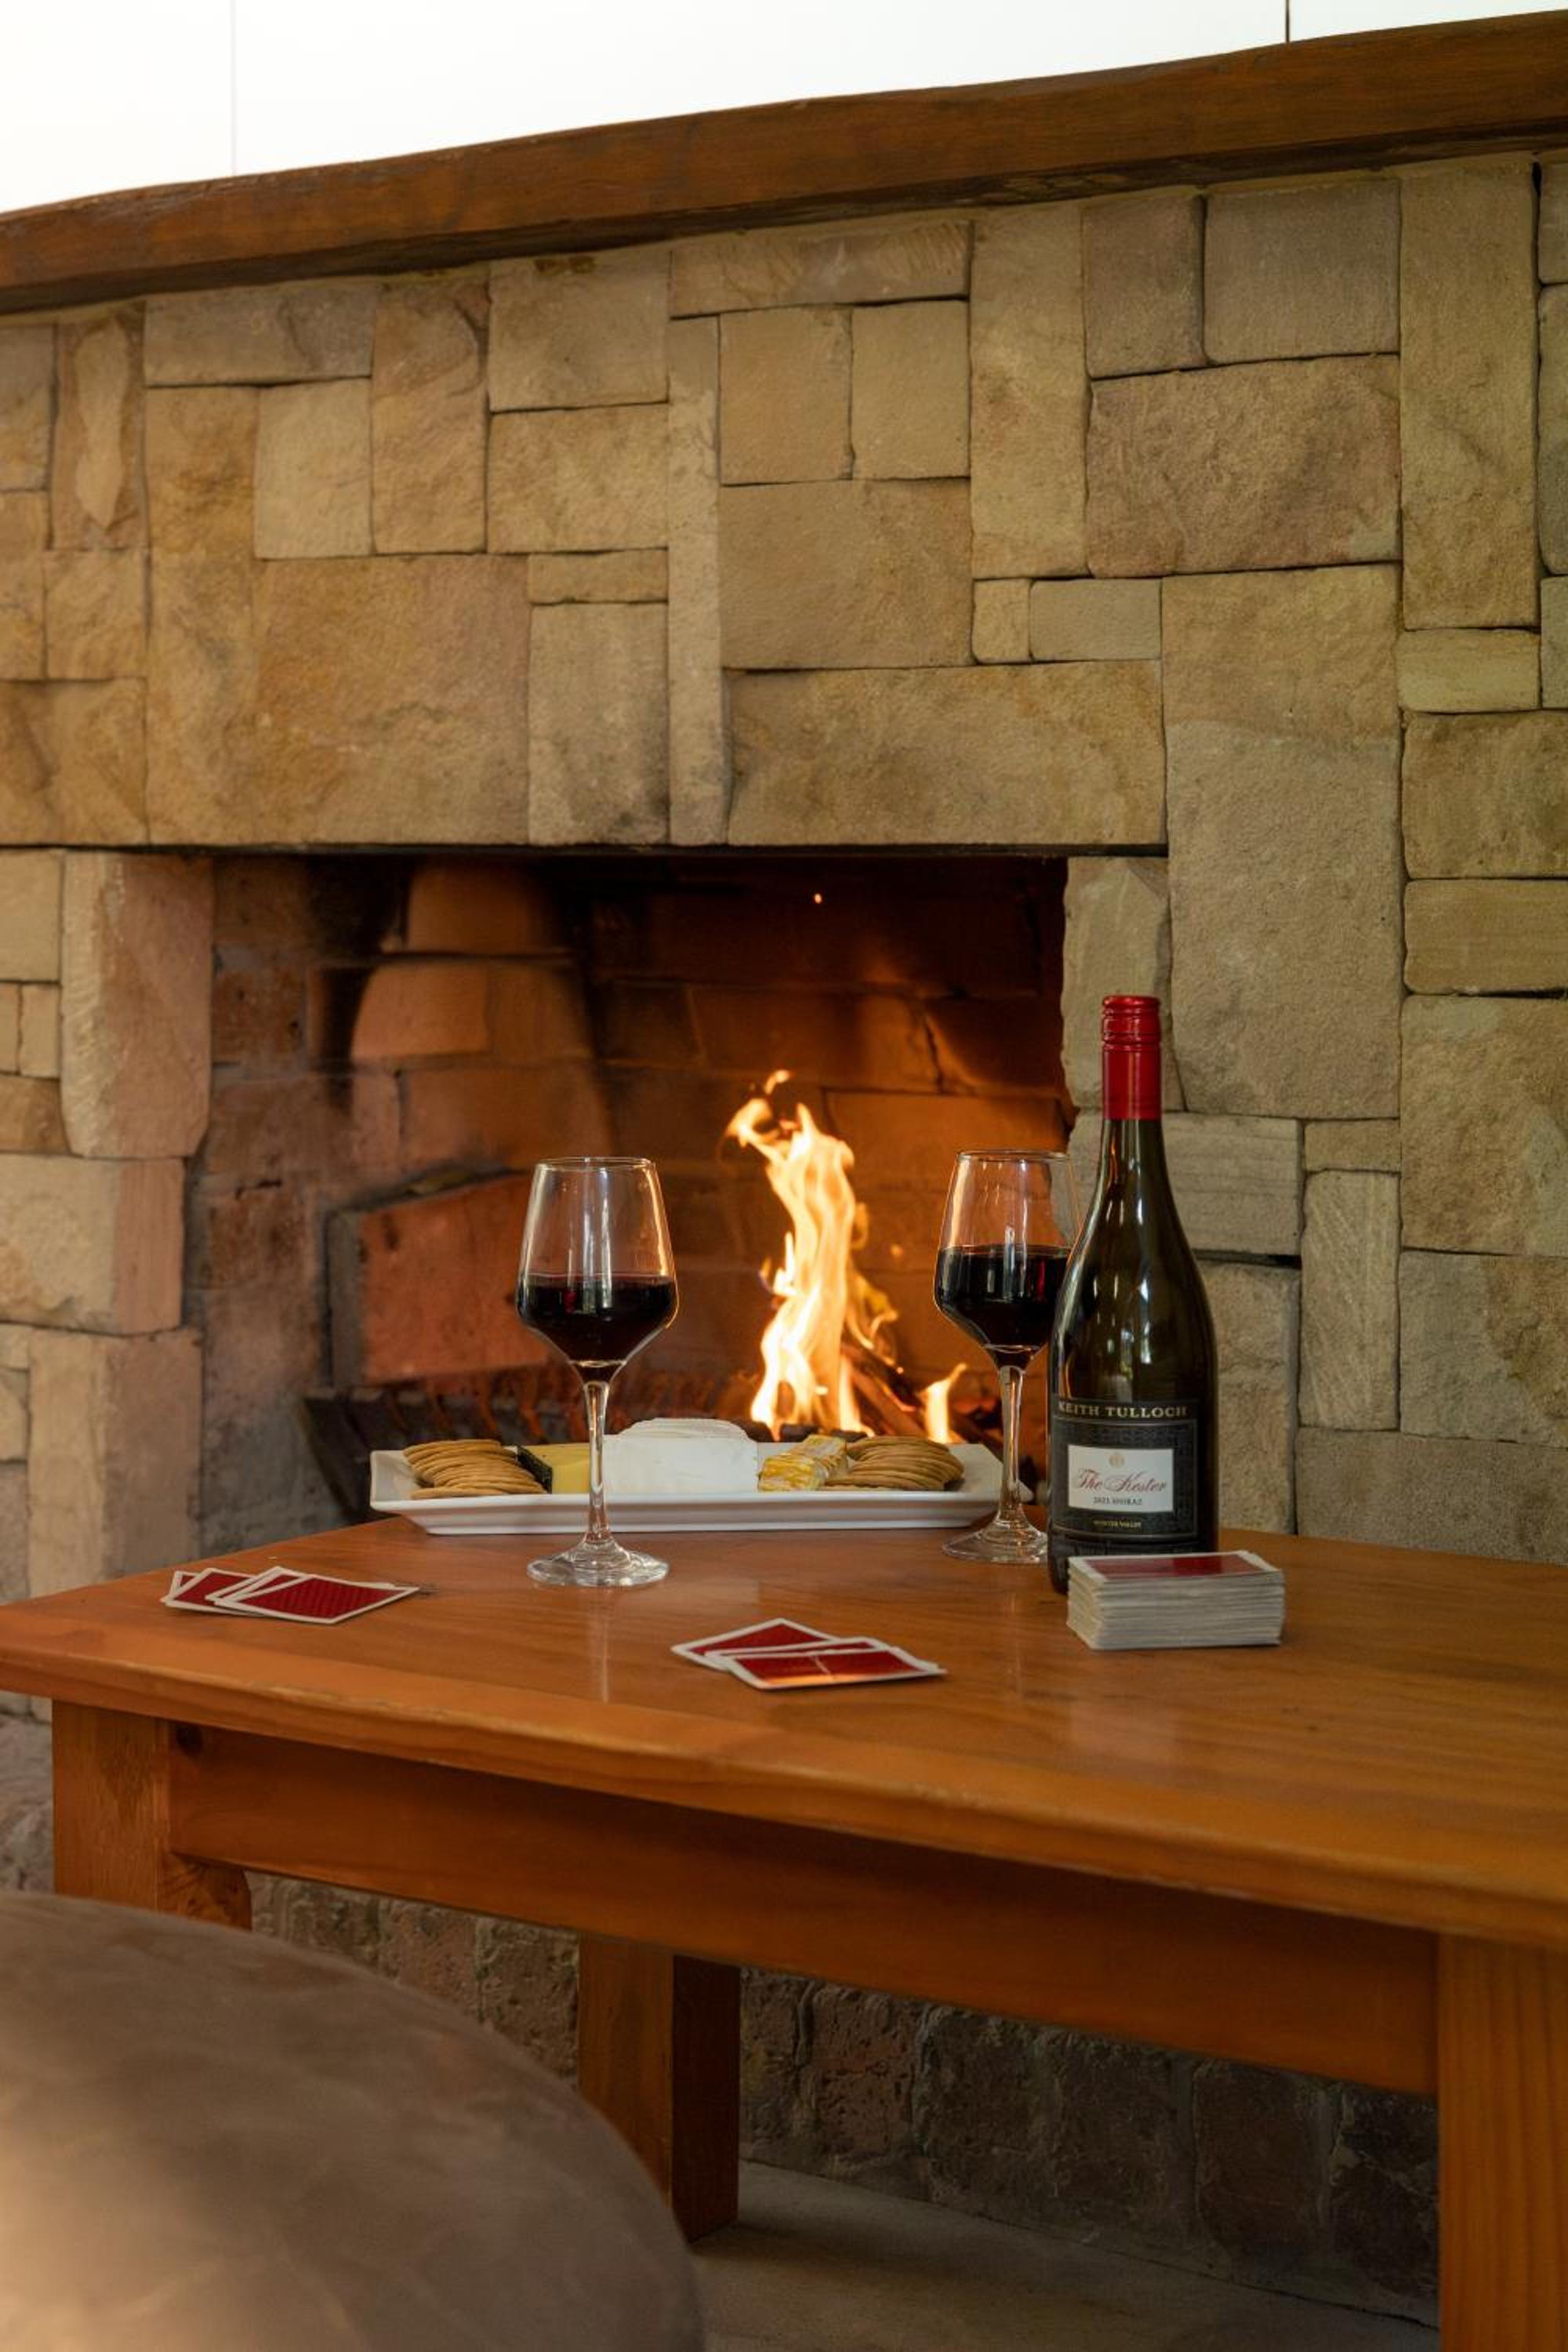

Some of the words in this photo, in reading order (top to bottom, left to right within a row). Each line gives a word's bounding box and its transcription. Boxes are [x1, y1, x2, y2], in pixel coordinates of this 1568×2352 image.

[1058, 1403, 1099, 1415] KEITH
[1105, 1406, 1187, 1418] TULLOCH
[1078, 1468, 1103, 1493] The
